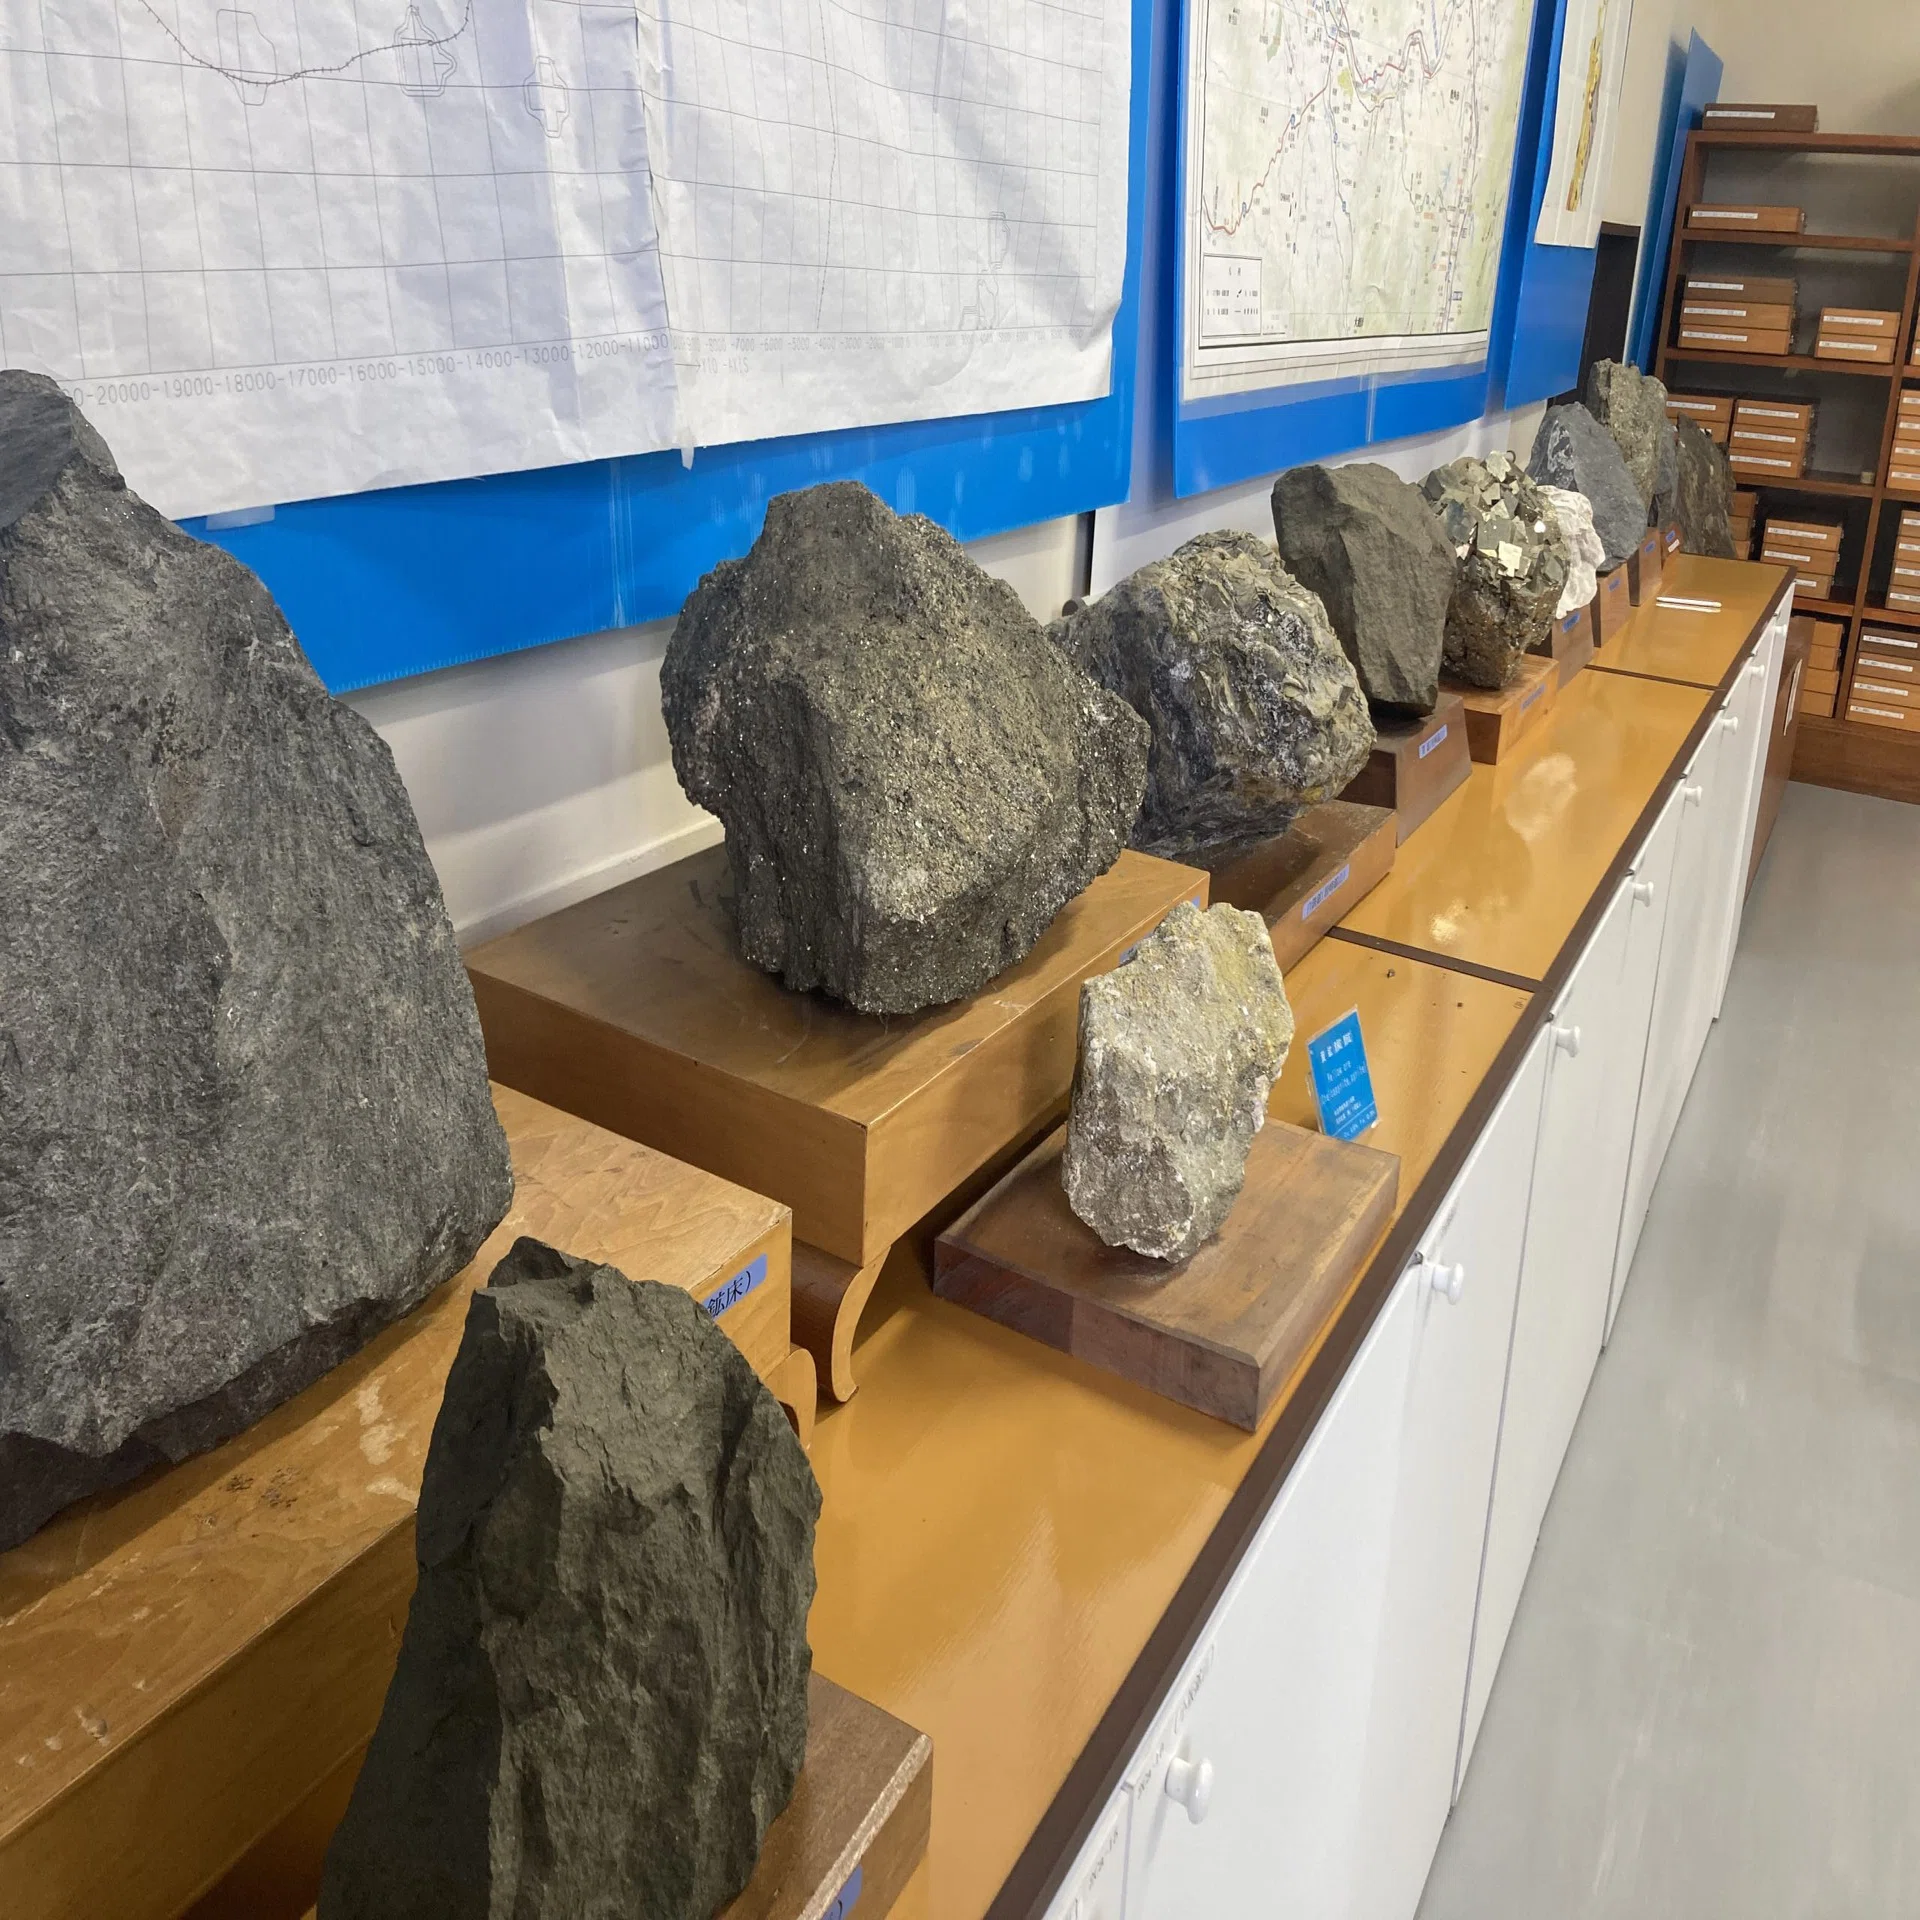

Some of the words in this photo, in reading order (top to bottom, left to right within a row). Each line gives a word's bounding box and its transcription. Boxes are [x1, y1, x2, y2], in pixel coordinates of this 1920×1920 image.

[152, 376, 213, 400] -19000
[215, 371, 276, 393] -18000
[277, 367, 337, 387] -17000
[339, 361, 397, 382] -16000
[399, 357, 456, 376] -15000
[457, 351, 512, 370] -14000
[514, 345, 569, 365] -13000
[571, 339, 619, 359] -12000
